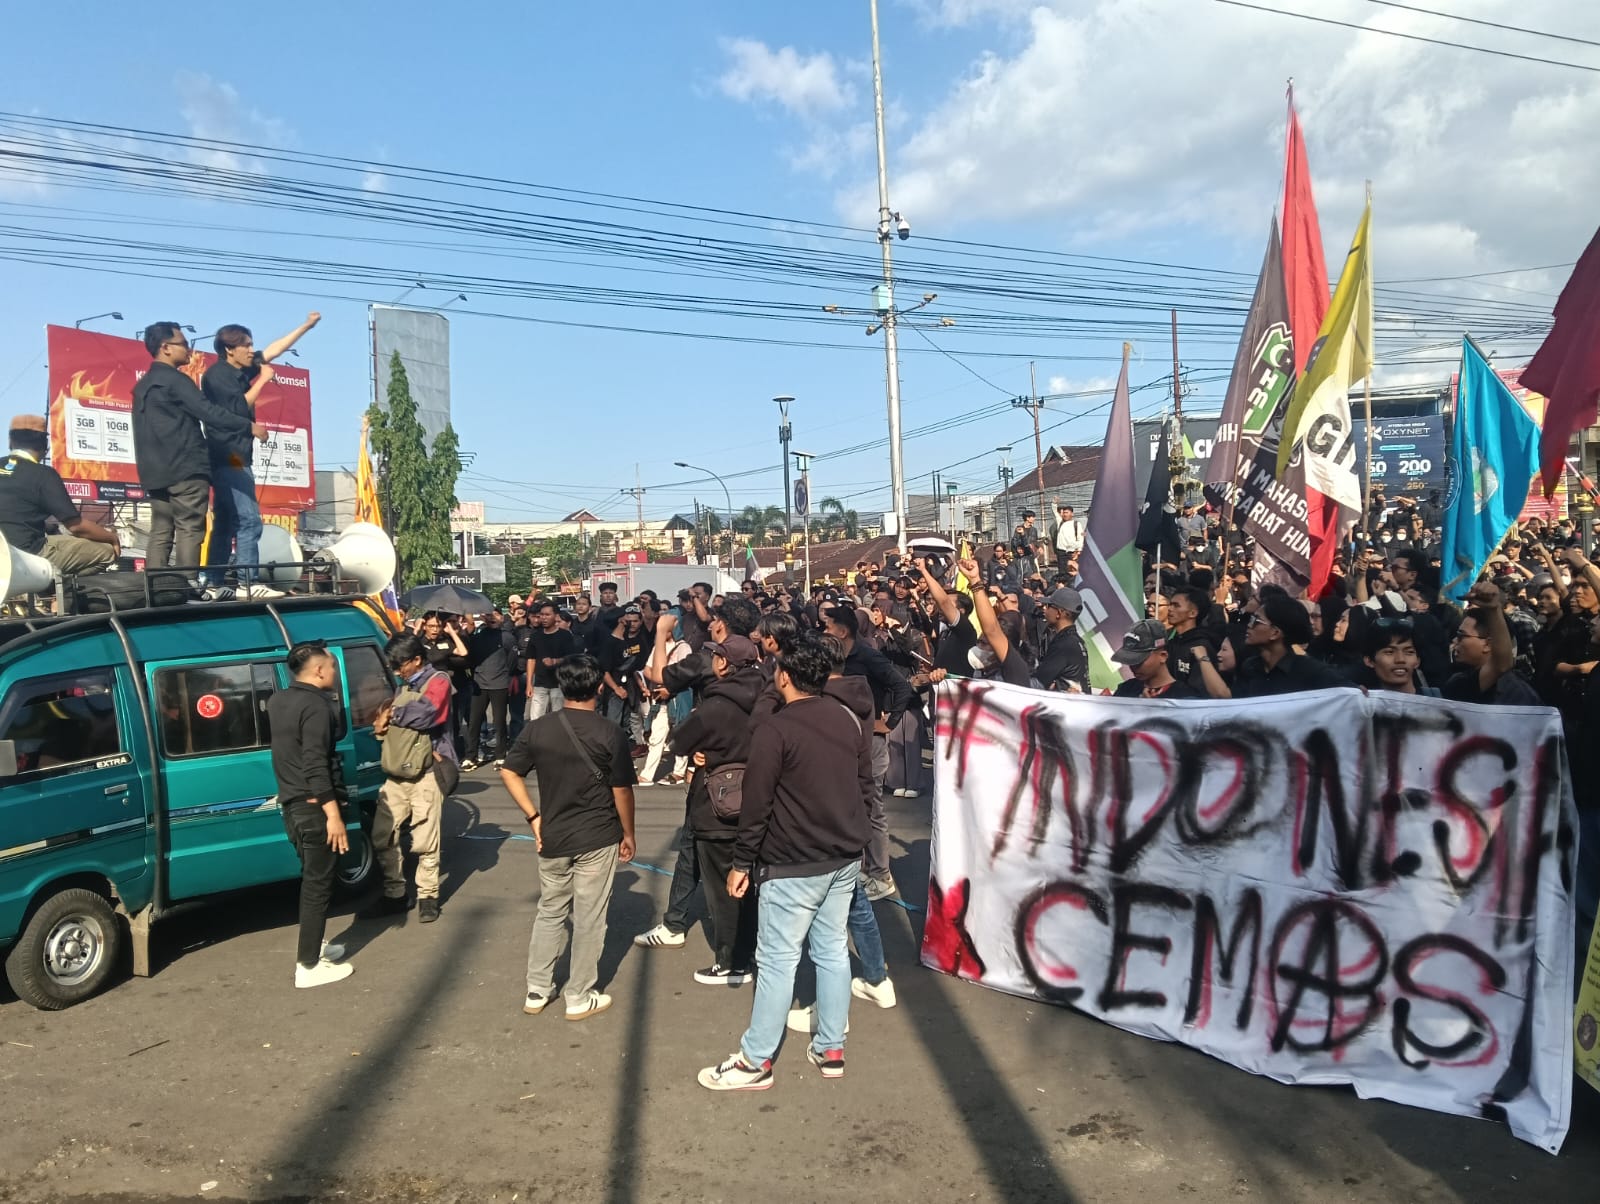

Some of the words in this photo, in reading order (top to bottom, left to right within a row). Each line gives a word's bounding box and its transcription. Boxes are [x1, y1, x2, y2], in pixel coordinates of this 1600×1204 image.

[76, 418, 95, 428] 3GB
[107, 422, 129, 431] 10GB
[1383, 427, 1431, 436] OXYNET
[1399, 459, 1432, 474] 200
[96, 757, 127, 769] EXTRA
[1014, 878, 1507, 1071] CEMAS
